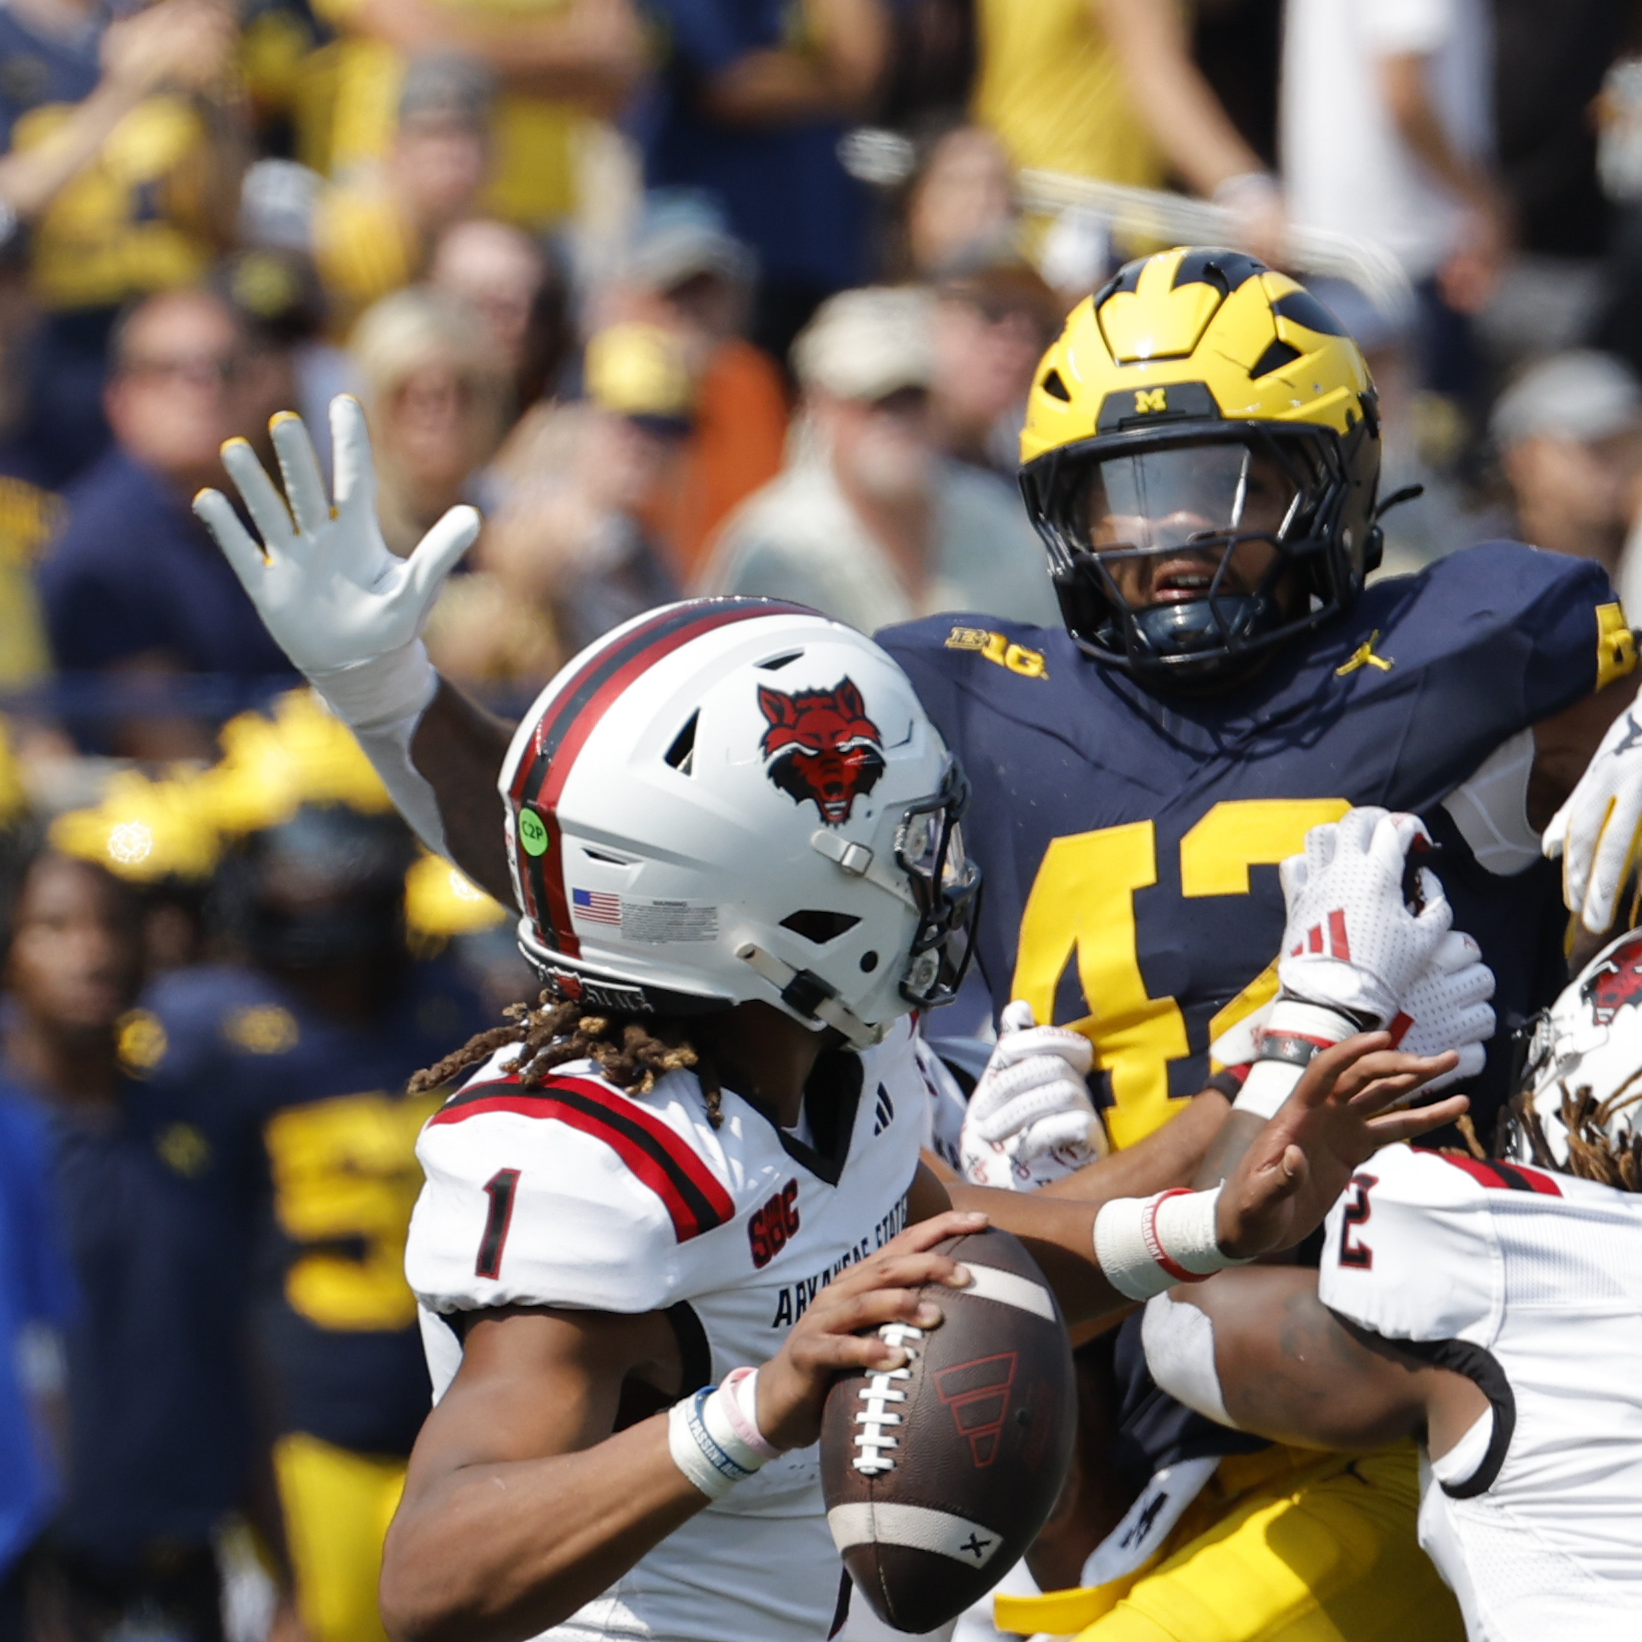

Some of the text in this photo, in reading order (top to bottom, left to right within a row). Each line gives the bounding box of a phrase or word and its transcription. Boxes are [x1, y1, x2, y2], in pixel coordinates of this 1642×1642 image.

[1135, 388, 1167, 413] M
[1010, 798, 1355, 1152] 42
[476, 1167, 522, 1280] 1
[1142, 1206, 1165, 1260] ACADEMY
[1339, 1172, 1379, 1271] 2
